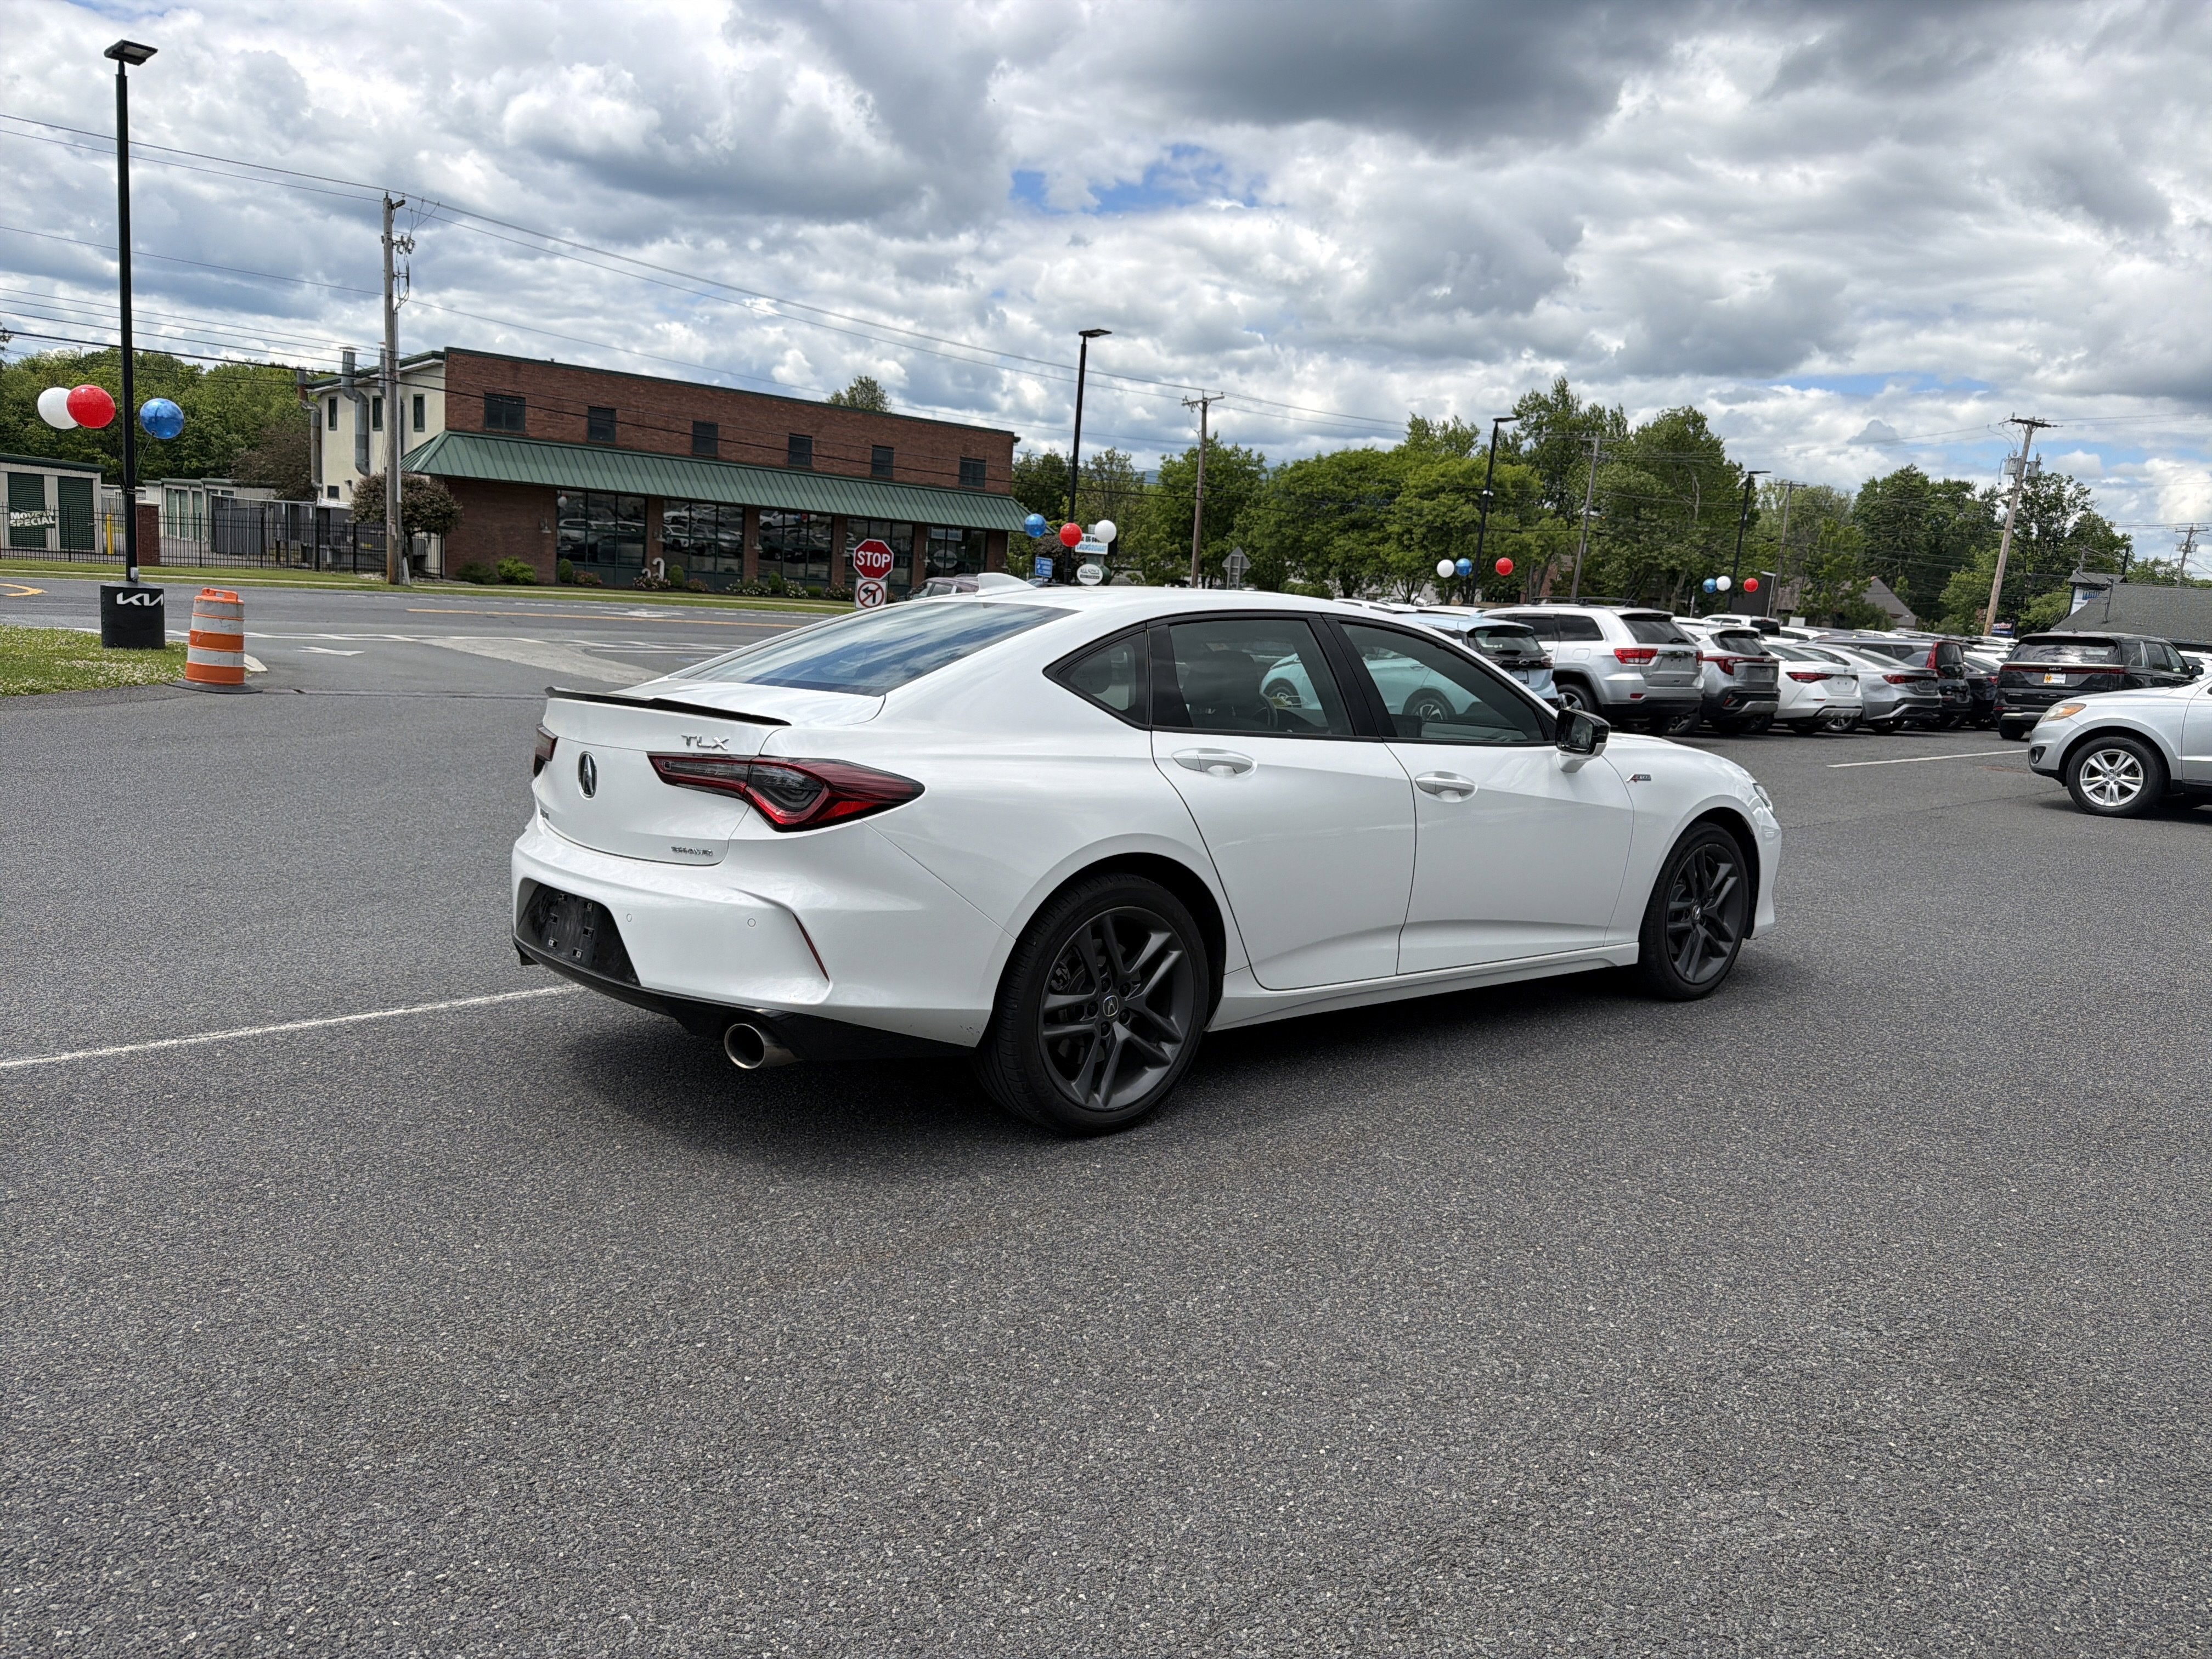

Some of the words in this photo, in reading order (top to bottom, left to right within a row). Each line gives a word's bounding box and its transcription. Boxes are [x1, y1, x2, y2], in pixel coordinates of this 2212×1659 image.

[9, 516, 55, 527] SPECIAL
[856, 551, 890, 568] STOP
[116, 592, 163, 606] KIA
[681, 735, 730, 751] TLX
